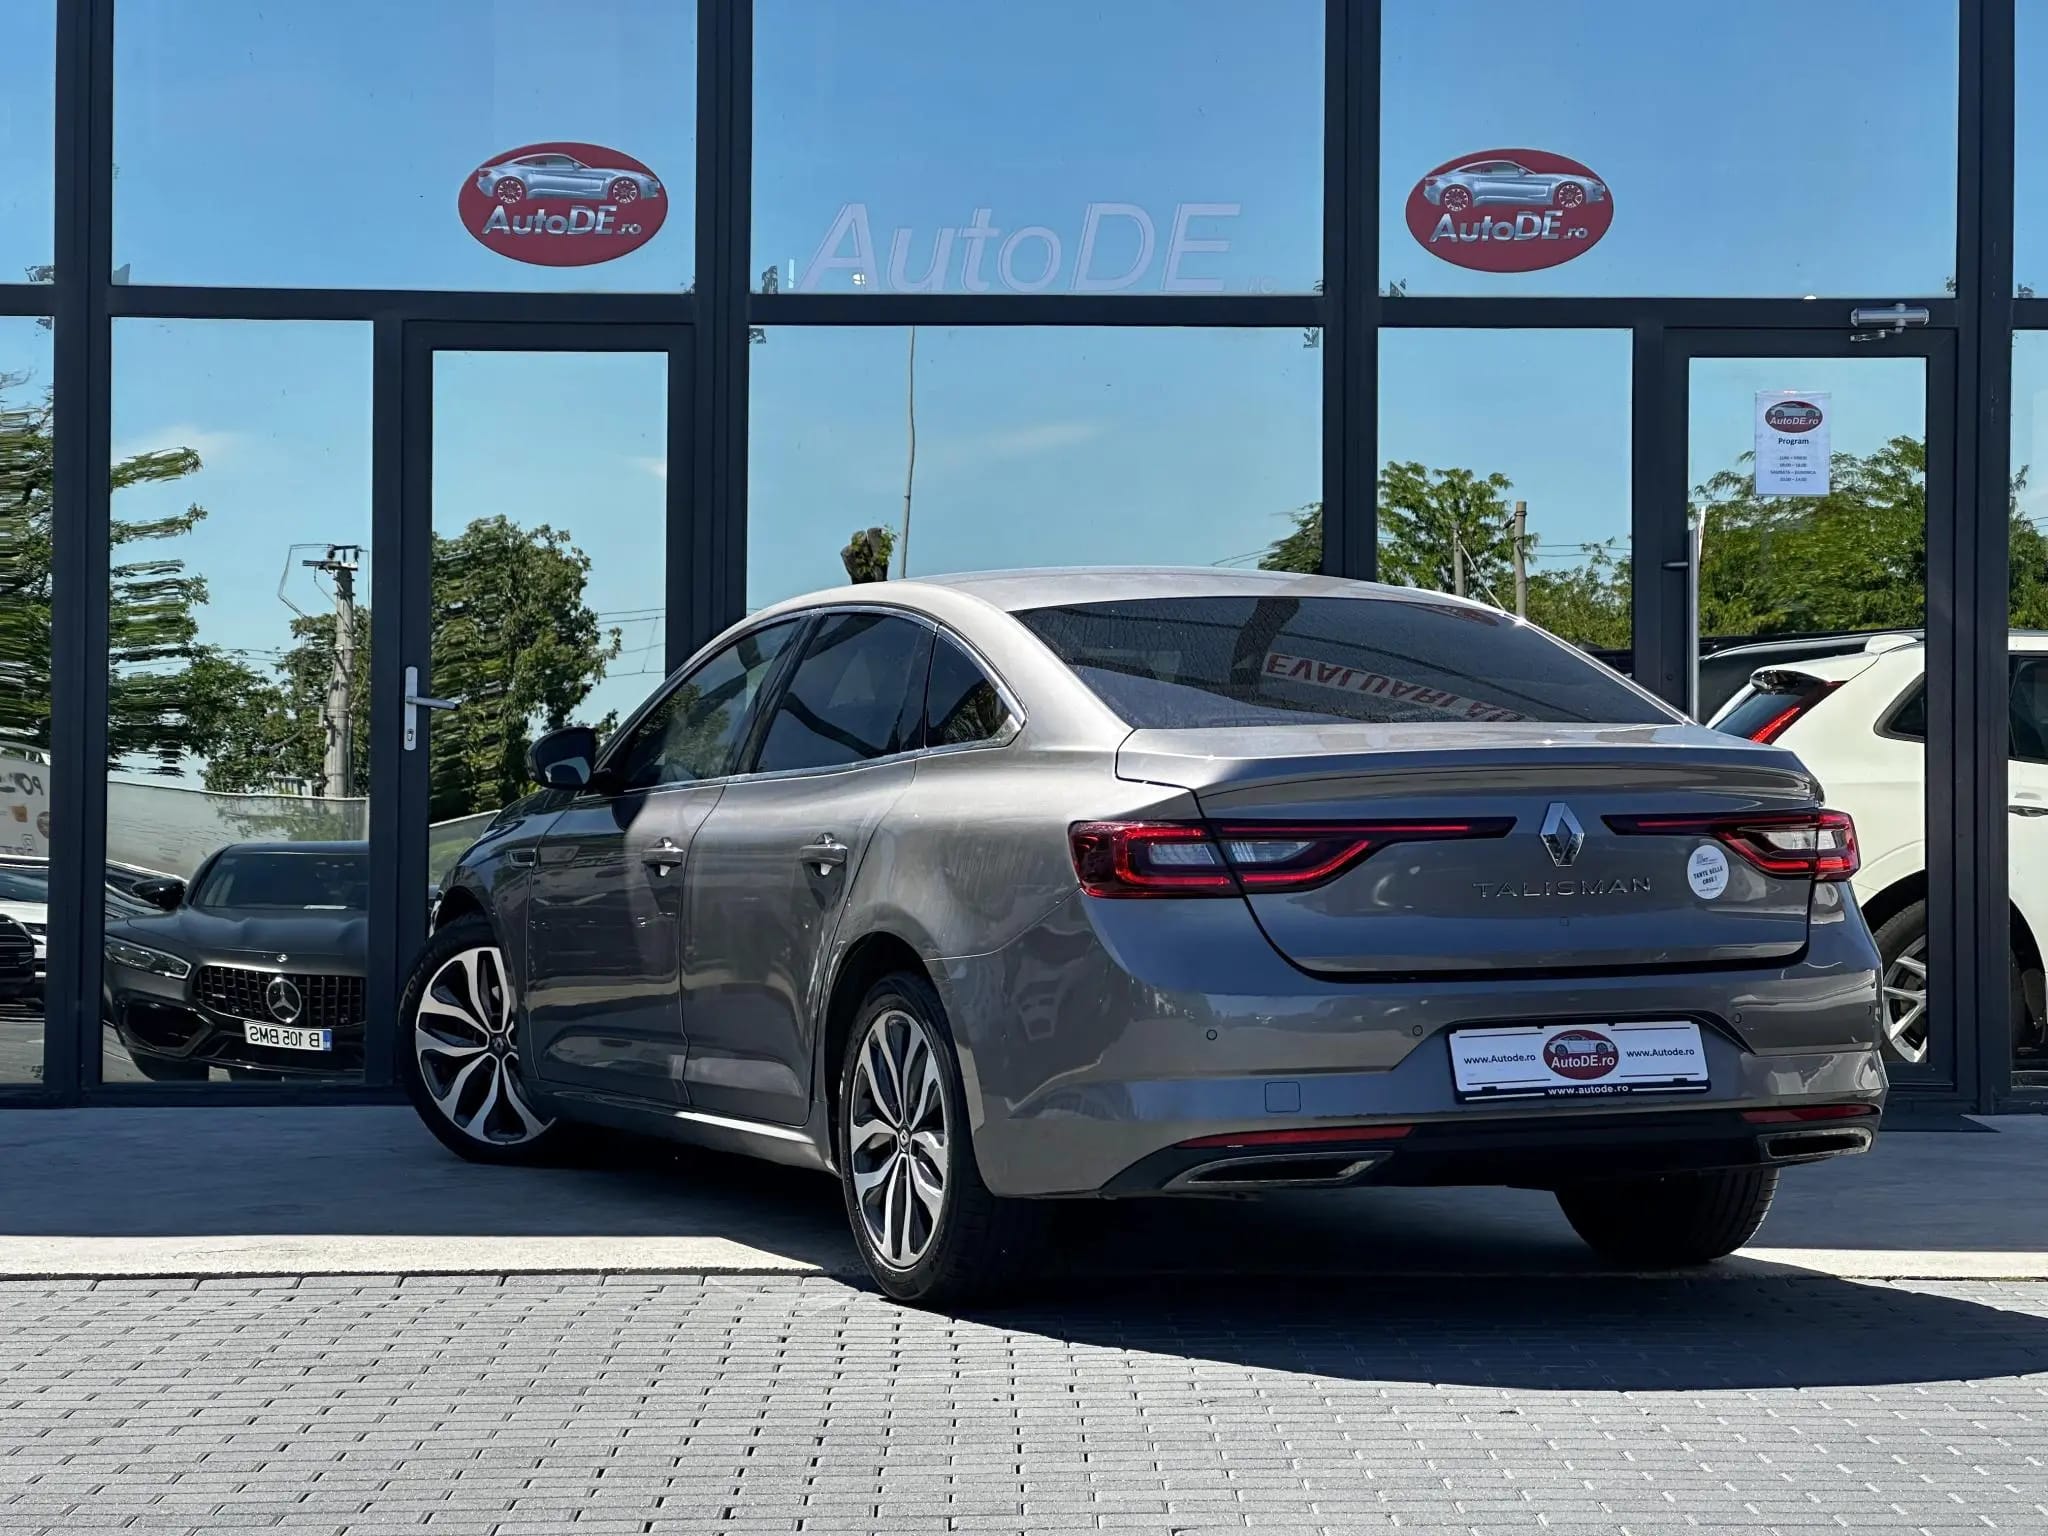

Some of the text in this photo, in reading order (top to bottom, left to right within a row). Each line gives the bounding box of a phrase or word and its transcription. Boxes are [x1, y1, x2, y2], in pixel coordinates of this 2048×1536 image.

[799, 203, 1241, 293] AutoDE
[1769, 416, 1819, 425] AutoDE.ro
[1778, 438, 1809, 446] Program
[1472, 878, 1651, 898] TALISMAN
[1463, 1053, 1537, 1065] www.Autode.ro
[1626, 1048, 1695, 1058] www.Autode.ro
[1551, 1054, 1615, 1069] AutoDE.ro
[1547, 1084, 1629, 1096] www.autode.ro
